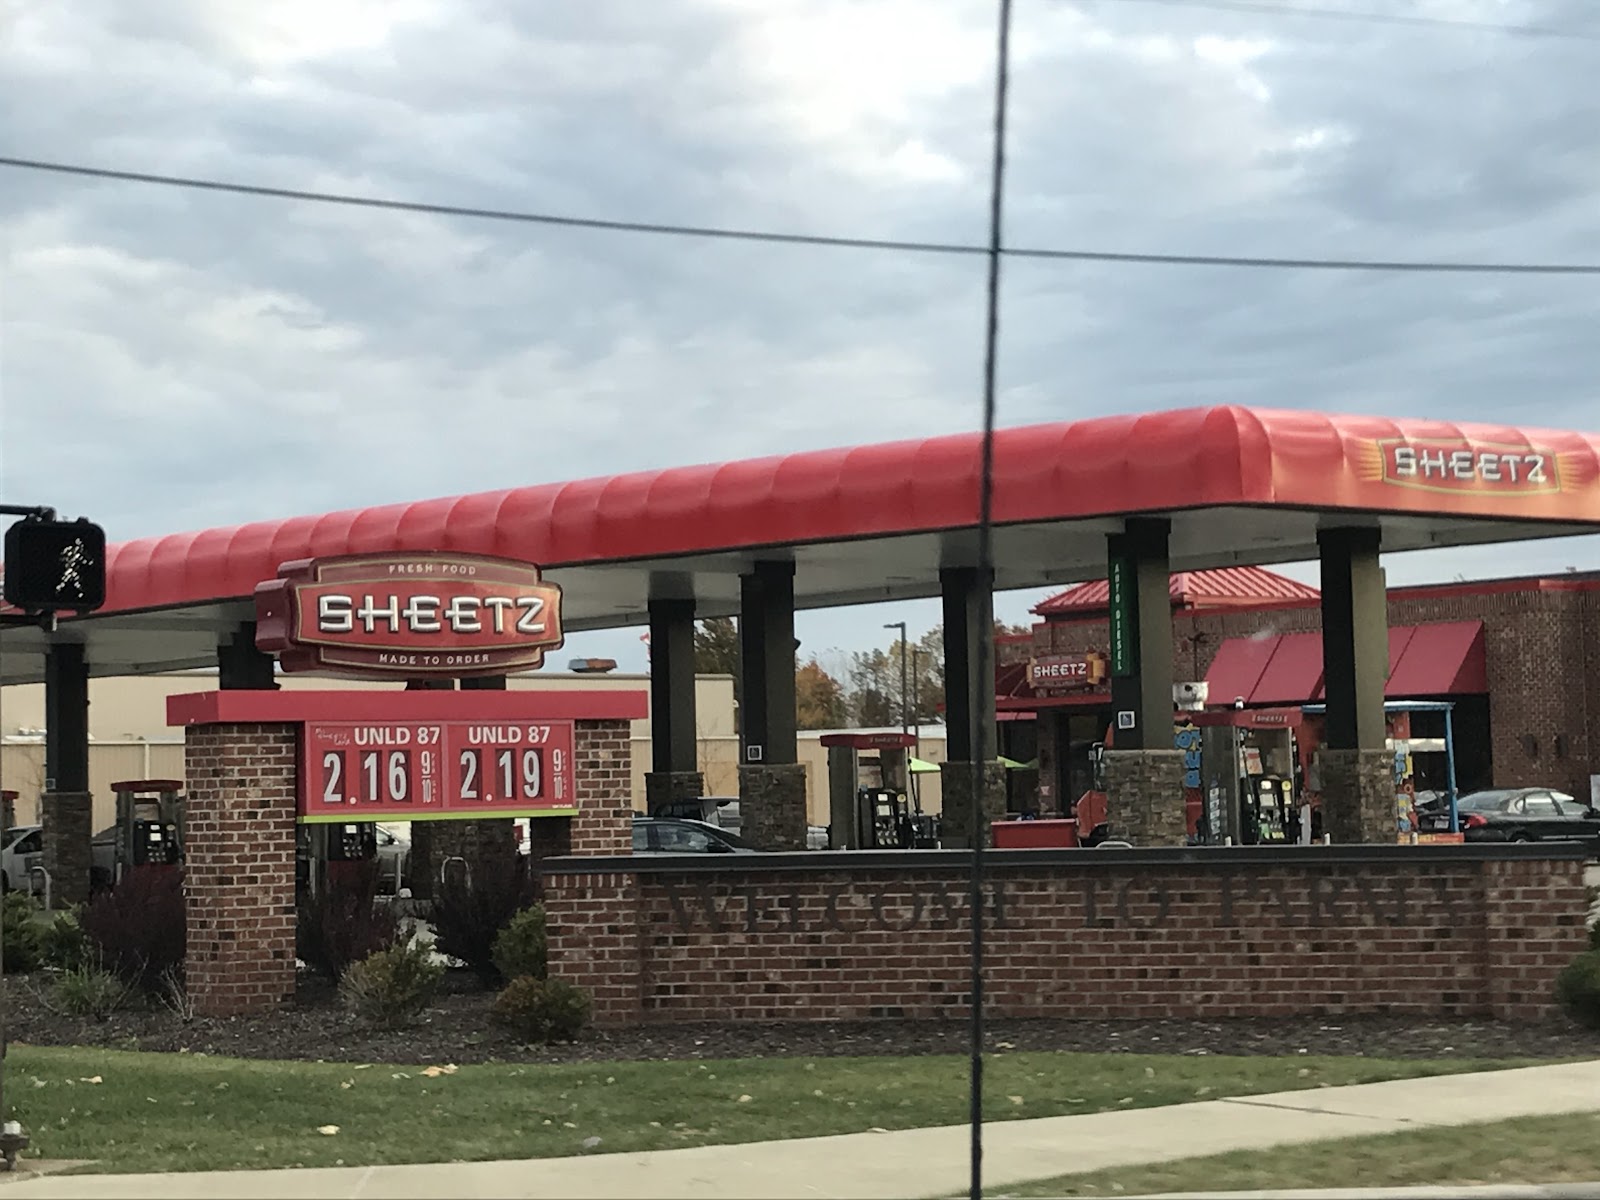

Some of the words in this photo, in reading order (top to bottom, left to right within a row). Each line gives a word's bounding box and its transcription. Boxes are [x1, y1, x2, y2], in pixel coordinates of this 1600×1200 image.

[1394, 446, 1547, 483] SHEETZ
[388, 563, 434, 575] FRESH
[442, 563, 477, 577] FOOD
[319, 594, 546, 634] SHEETZ
[378, 653, 417, 666] MADE
[424, 655, 440, 666] TO
[447, 653, 490, 665] ORDER
[1033, 662, 1087, 679] SHEETZ
[354, 726, 411, 746] UNLD
[416, 726, 441, 745] 87
[470, 726, 521, 744] UNLD
[527, 726, 551, 744] 87
[323, 751, 408, 805] 2.16
[460, 750, 541, 802] 2.19
